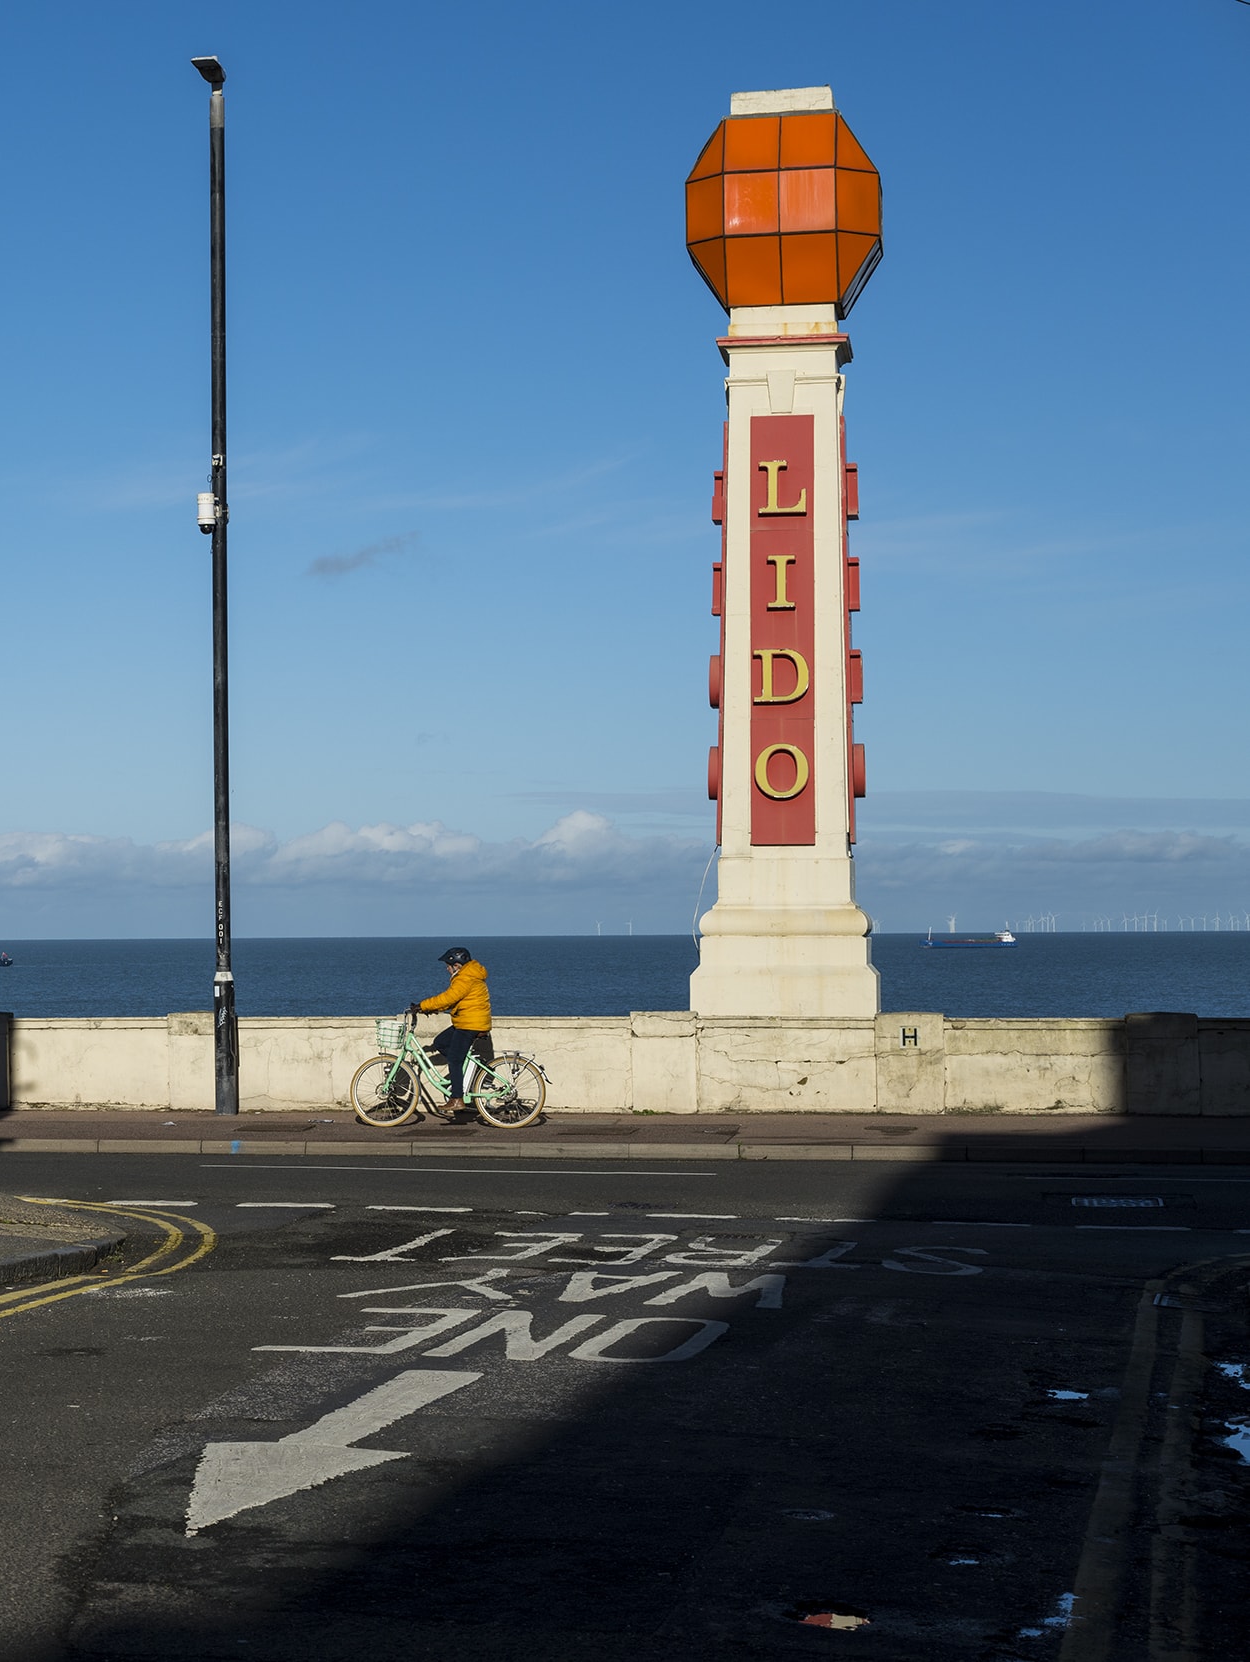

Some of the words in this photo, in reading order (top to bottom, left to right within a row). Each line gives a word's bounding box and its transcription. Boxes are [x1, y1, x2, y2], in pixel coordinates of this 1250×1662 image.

[751, 459, 811, 800] LIDO
[902, 1027, 918, 1047] H
[330, 1228, 989, 1276] STREET
[336, 1268, 787, 1309] WAY
[251, 1308, 730, 1364] ONE
